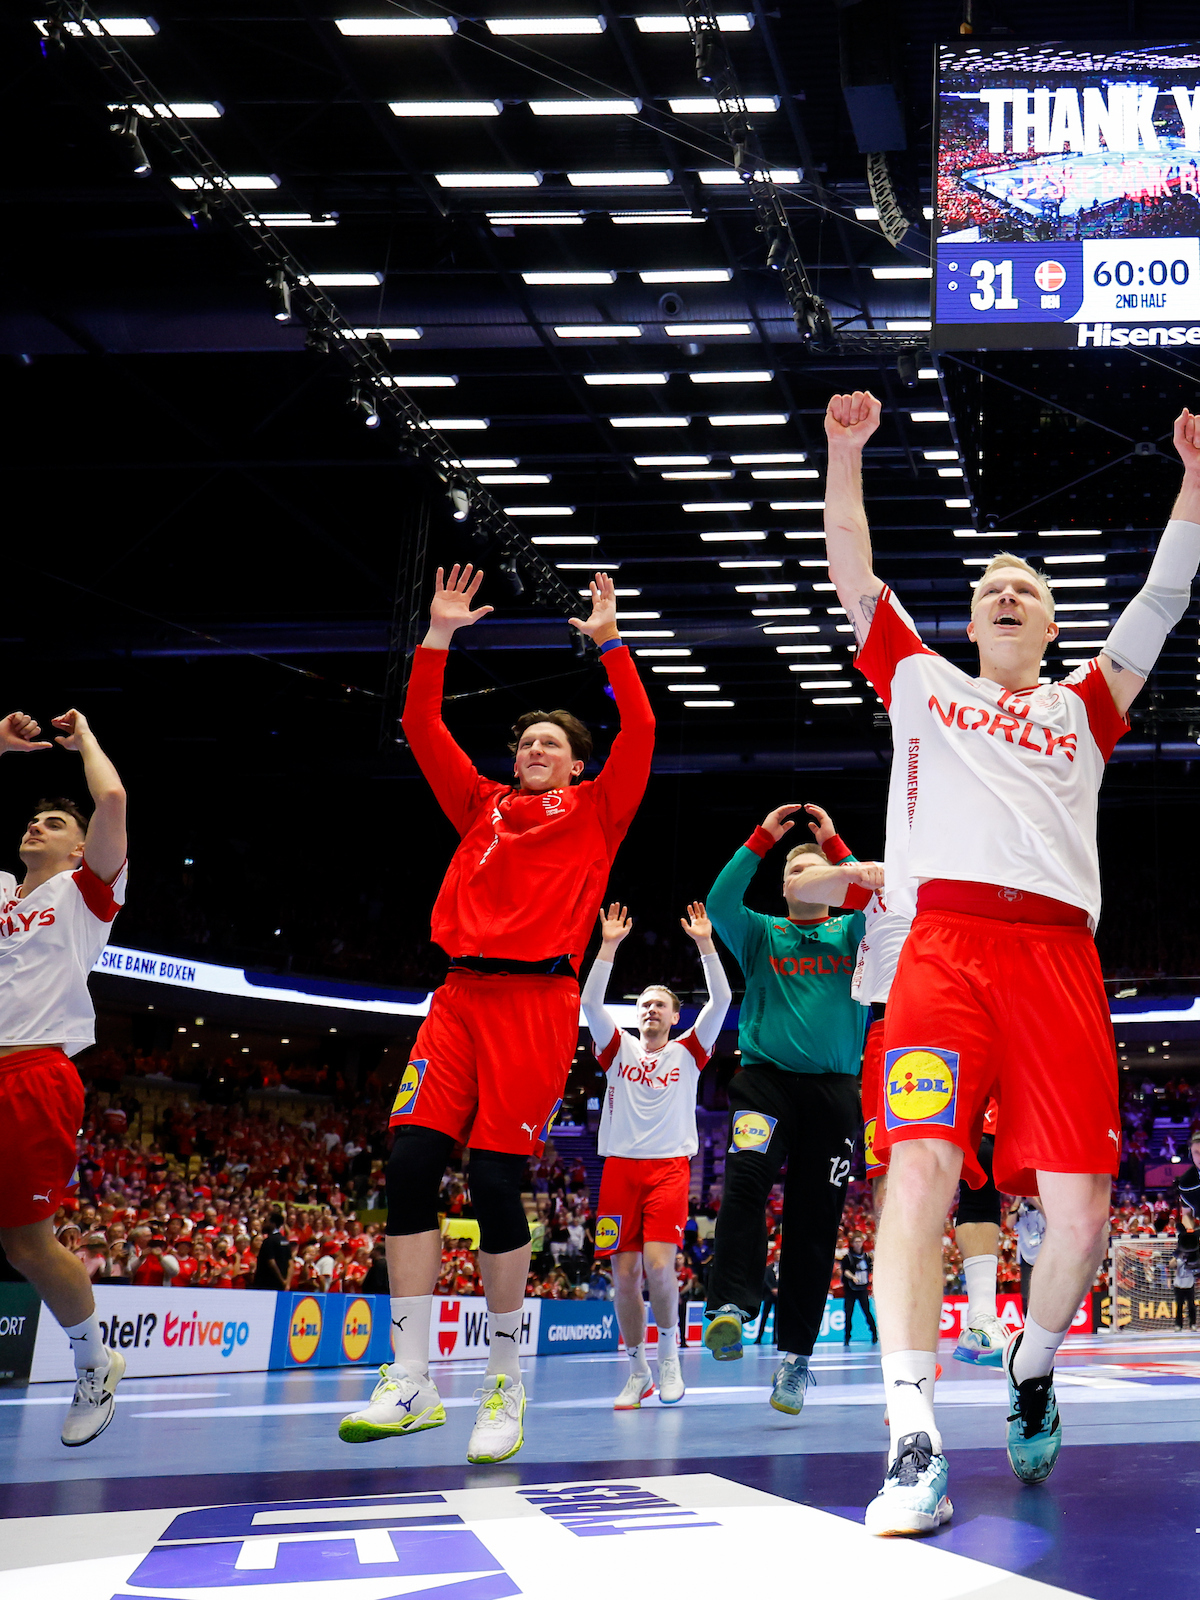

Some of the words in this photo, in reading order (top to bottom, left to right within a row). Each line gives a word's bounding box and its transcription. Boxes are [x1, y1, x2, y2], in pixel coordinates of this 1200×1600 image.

[980, 85, 1159, 153] THANK
[1103, 164, 1173, 198] BANK
[969, 259, 1019, 311] 31
[1093, 259, 1190, 287] 60:00
[1116, 294, 1139, 308] 2ND
[1141, 293, 1167, 308] HALF
[928, 694, 1078, 763] NORLYS
[100, 951, 124, 969] SKE
[125, 956, 158, 976] BANK
[159, 962, 197, 982] BOXEN
[399, 1082, 414, 1094] DL
[829, 1155, 851, 1187] 12
[99, 1313, 157, 1349] otel?
[163, 1311, 250, 1358] trivago
[549, 1325, 602, 1342] GRUNDFOS
